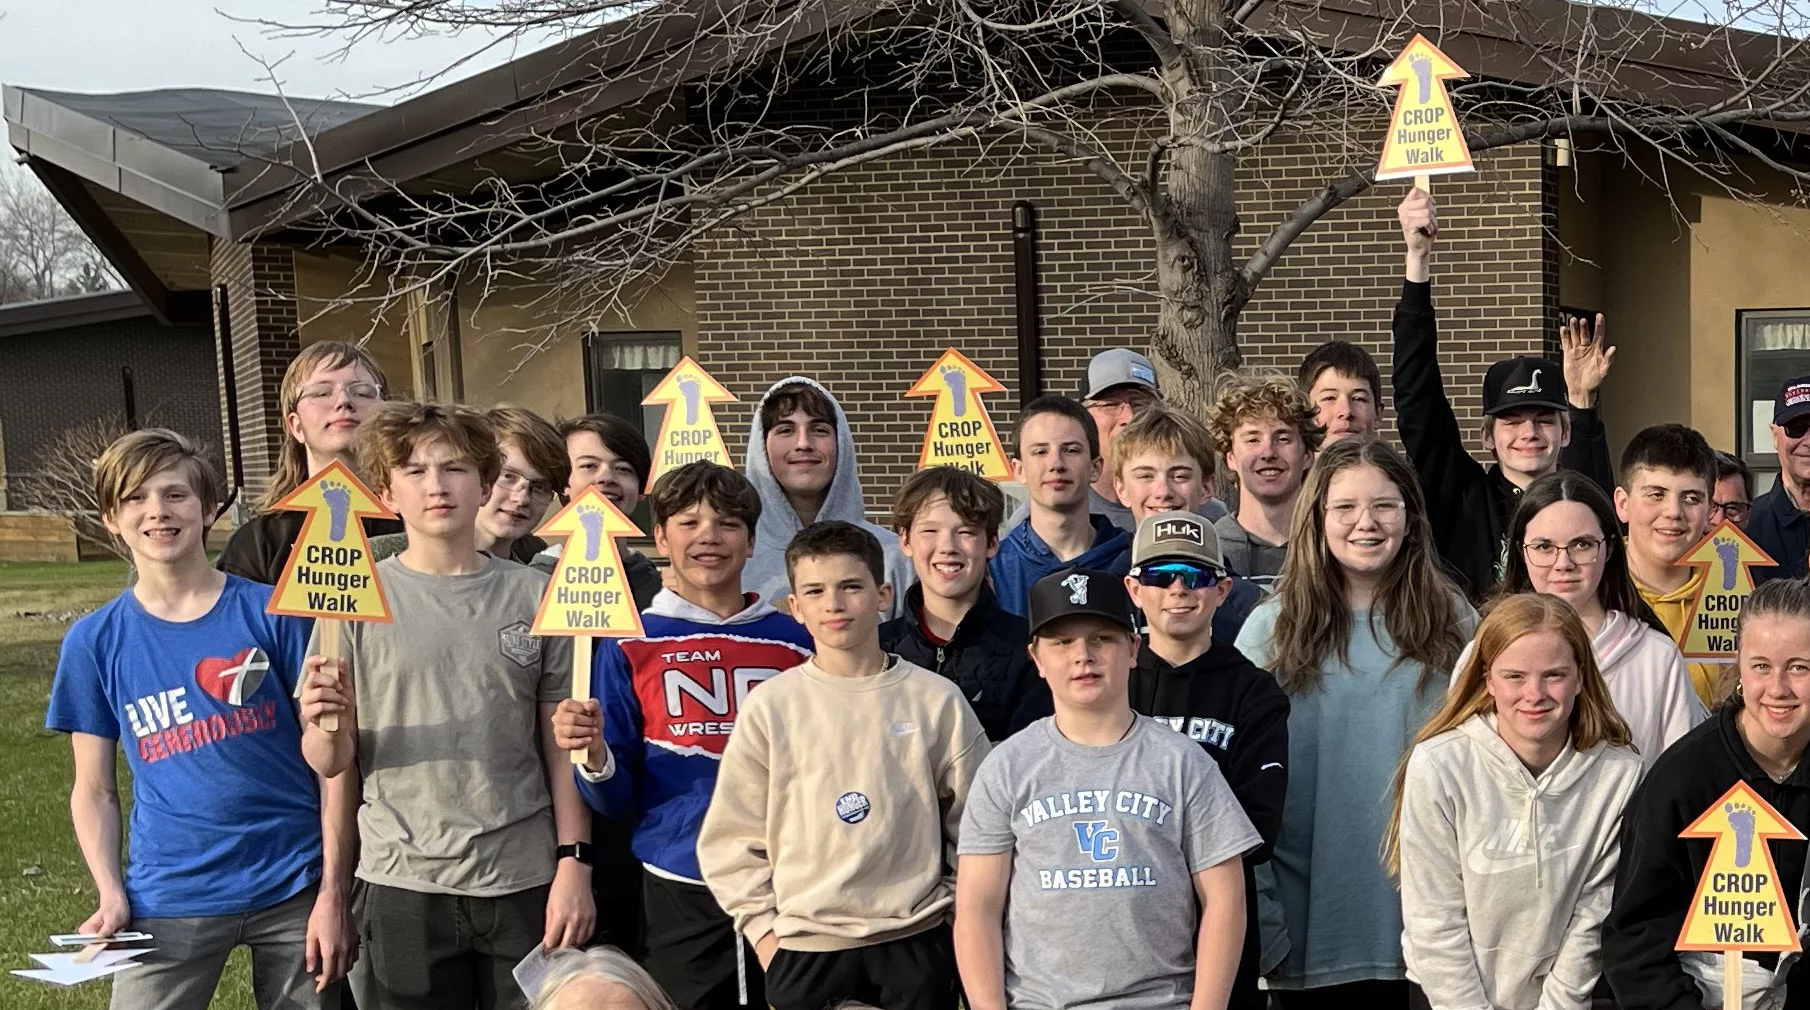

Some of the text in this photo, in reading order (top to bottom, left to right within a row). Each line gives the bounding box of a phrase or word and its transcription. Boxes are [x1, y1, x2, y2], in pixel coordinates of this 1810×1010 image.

[1403, 107, 1444, 127] CROP
[1397, 127, 1453, 147] Hunger
[1405, 147, 1445, 165] Walk
[671, 429, 713, 446] CROP
[938, 421, 982, 439] CROP
[932, 440, 991, 459] Hunger
[1156, 523, 1199, 539] Huk
[307, 545, 363, 567] CROP
[297, 566, 371, 591] Hunger
[561, 566, 615, 585] CROP
[307, 592, 358, 614] Walk
[553, 586, 618, 608] Hunger
[562, 610, 608, 629] Walk
[1698, 613, 1739, 633] Hung
[1707, 635, 1739, 652] Wal
[661, 650, 722, 664] TEAM
[125, 687, 194, 737] LIVE
[138, 700, 277, 763] GENEROUSLY
[668, 721, 734, 737] WRES
[1020, 788, 1173, 828] VALLEY CITY
[1039, 867, 1157, 890] BASEBALL
[1712, 872, 1768, 894] CROP
[1703, 896, 1776, 920] Hunger
[1714, 922, 1765, 944] Walk
